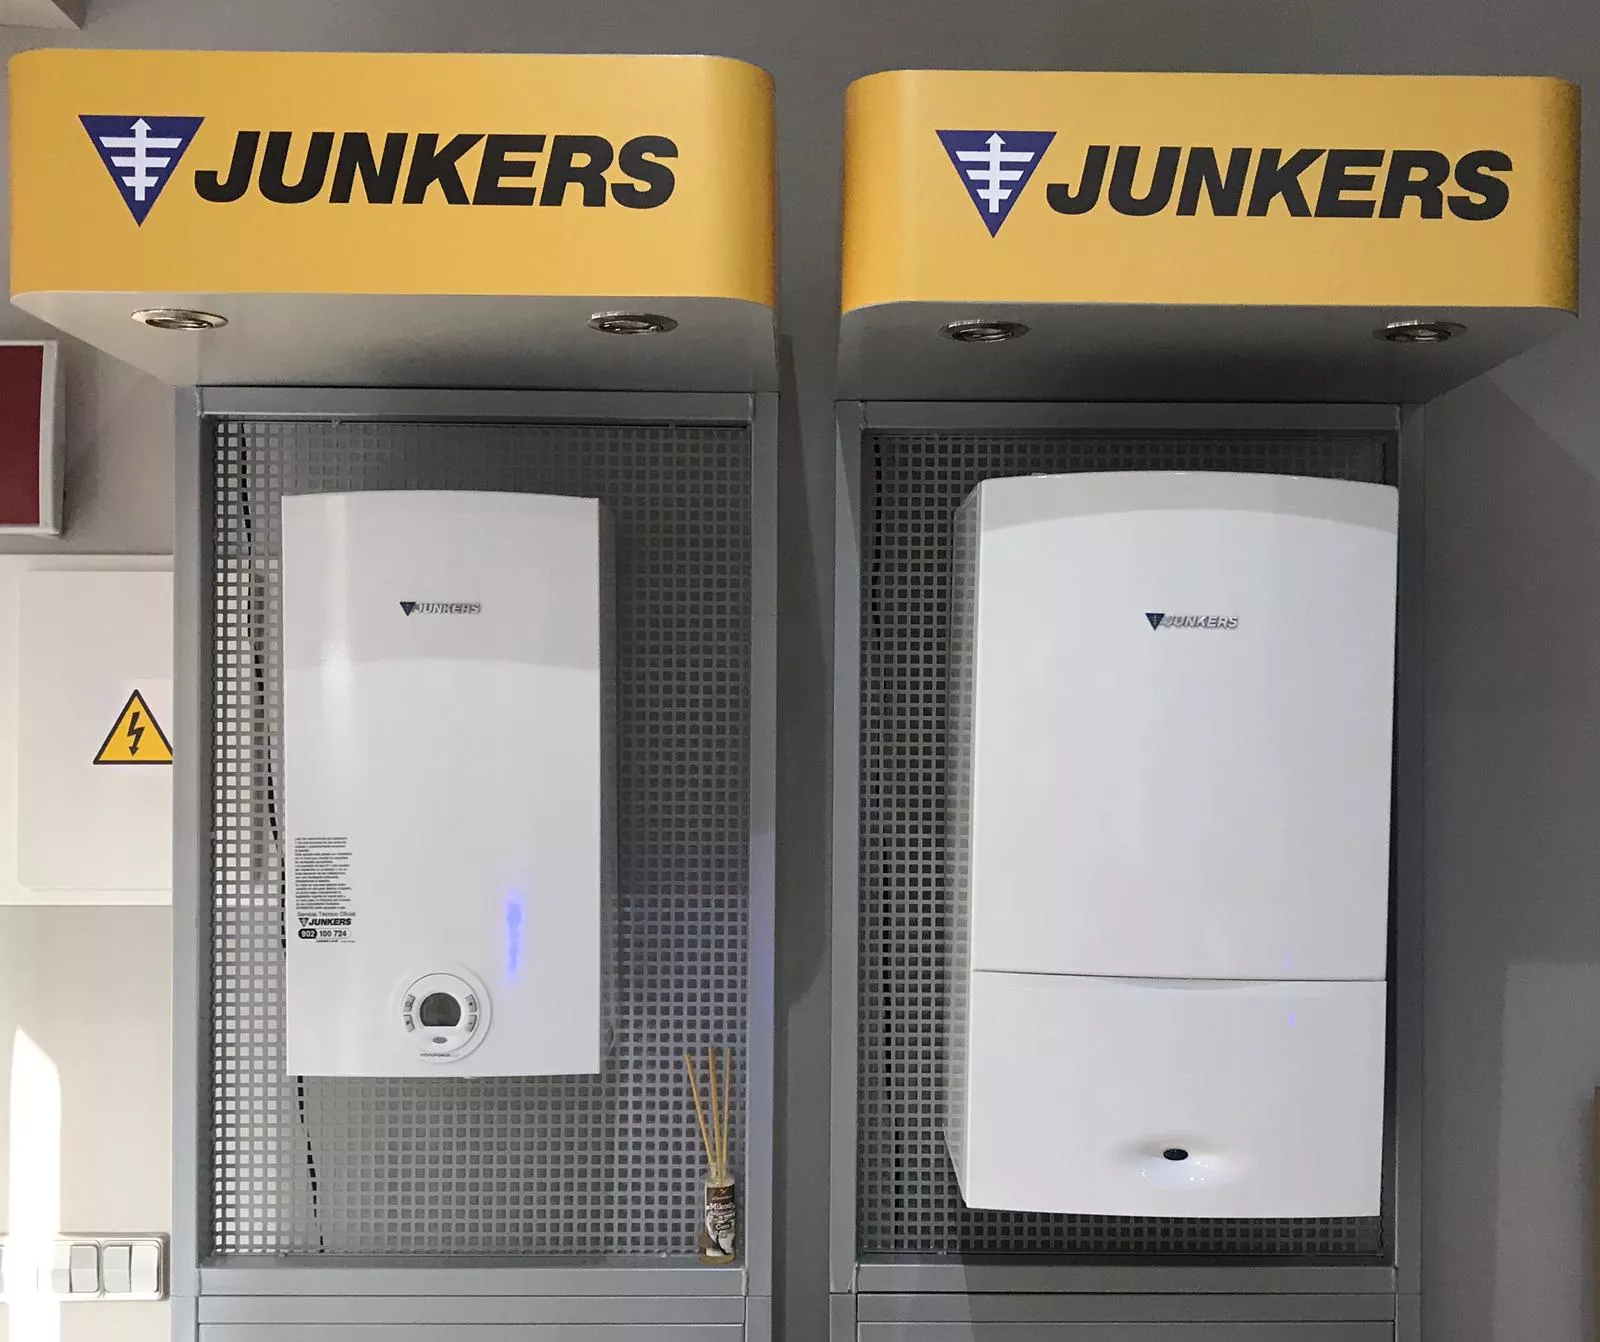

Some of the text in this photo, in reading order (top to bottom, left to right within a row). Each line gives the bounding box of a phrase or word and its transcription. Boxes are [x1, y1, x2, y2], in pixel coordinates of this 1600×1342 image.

[194, 130, 679, 210] JUNKERS
[1047, 145, 1513, 221] JUNKERS
[413, 602, 481, 615] JUNKERS
[1160, 615, 1239, 629] JUNKERS
[308, 918, 352, 926] JUNKERS
[301, 930, 347, 938] 902 100 724
